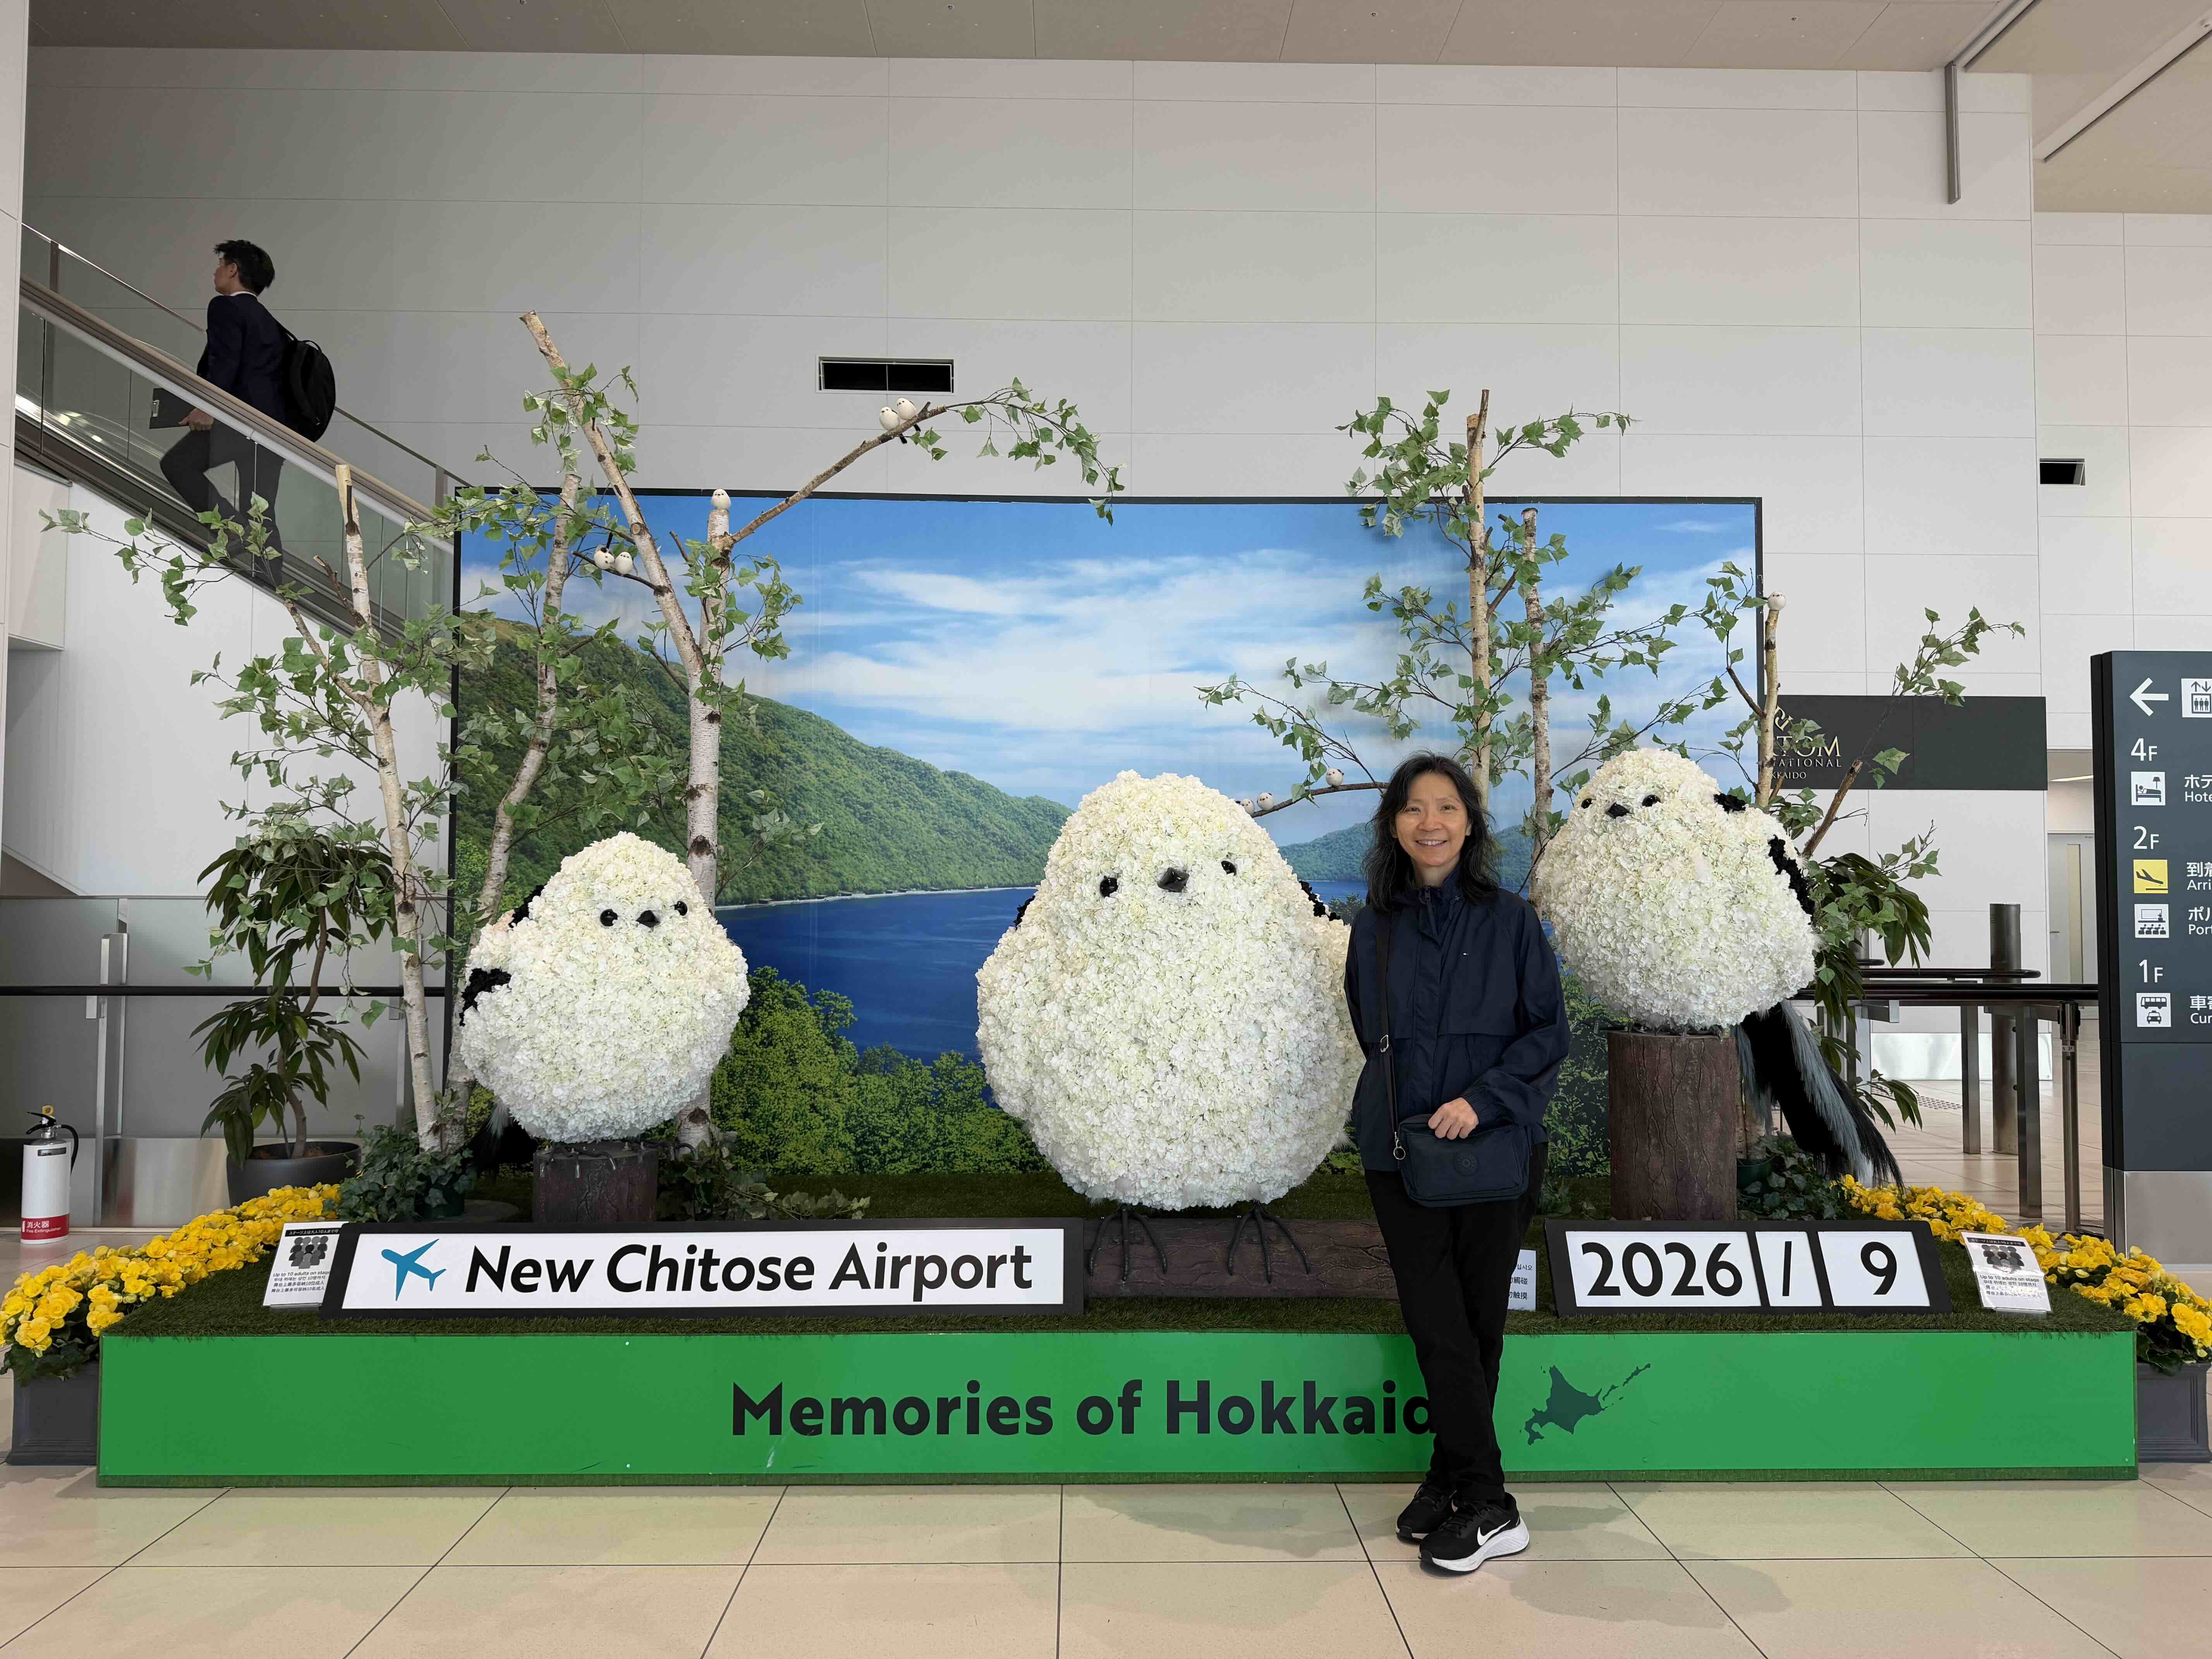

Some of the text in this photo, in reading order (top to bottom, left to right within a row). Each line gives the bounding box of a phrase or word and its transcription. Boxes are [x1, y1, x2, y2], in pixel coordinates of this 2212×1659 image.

[2131, 738, 2157, 761] 4F
[2133, 826, 2159, 850] 2F
[2139, 959, 2163, 983] 1F
[2190, 995, 2212, 1011] 車
[465, 1242, 1032, 1302] New Chitose Airport
[1582, 1242, 1743, 1297] 2026
[733, 1379, 1053, 1436] Memories
[1077, 1379, 1142, 1435] of
